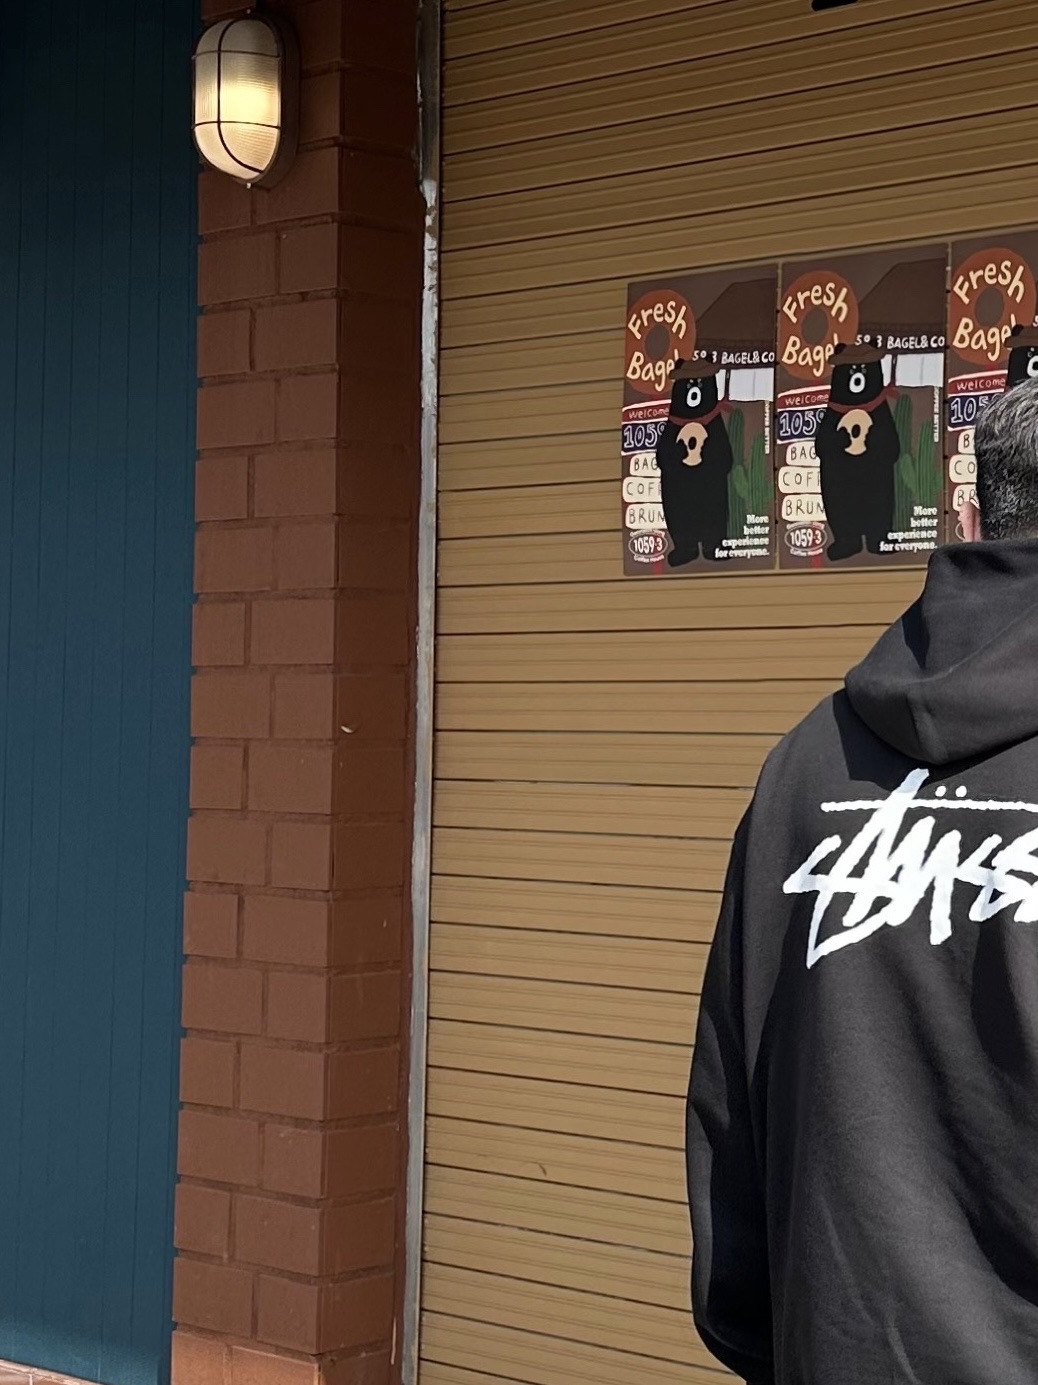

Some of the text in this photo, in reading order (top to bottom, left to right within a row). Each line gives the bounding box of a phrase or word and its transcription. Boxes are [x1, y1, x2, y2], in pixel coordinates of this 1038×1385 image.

[953, 260, 1024, 304] Fresh
[782, 283, 848, 323] Fresh
[628, 301, 686, 339] Fresh
[957, 379, 1005, 391] welcome
[785, 395, 830, 405] welcome
[629, 408, 668, 419] welcome
[633, 536, 663, 554] 1059-3
[789, 529, 823, 547] 1059-3
